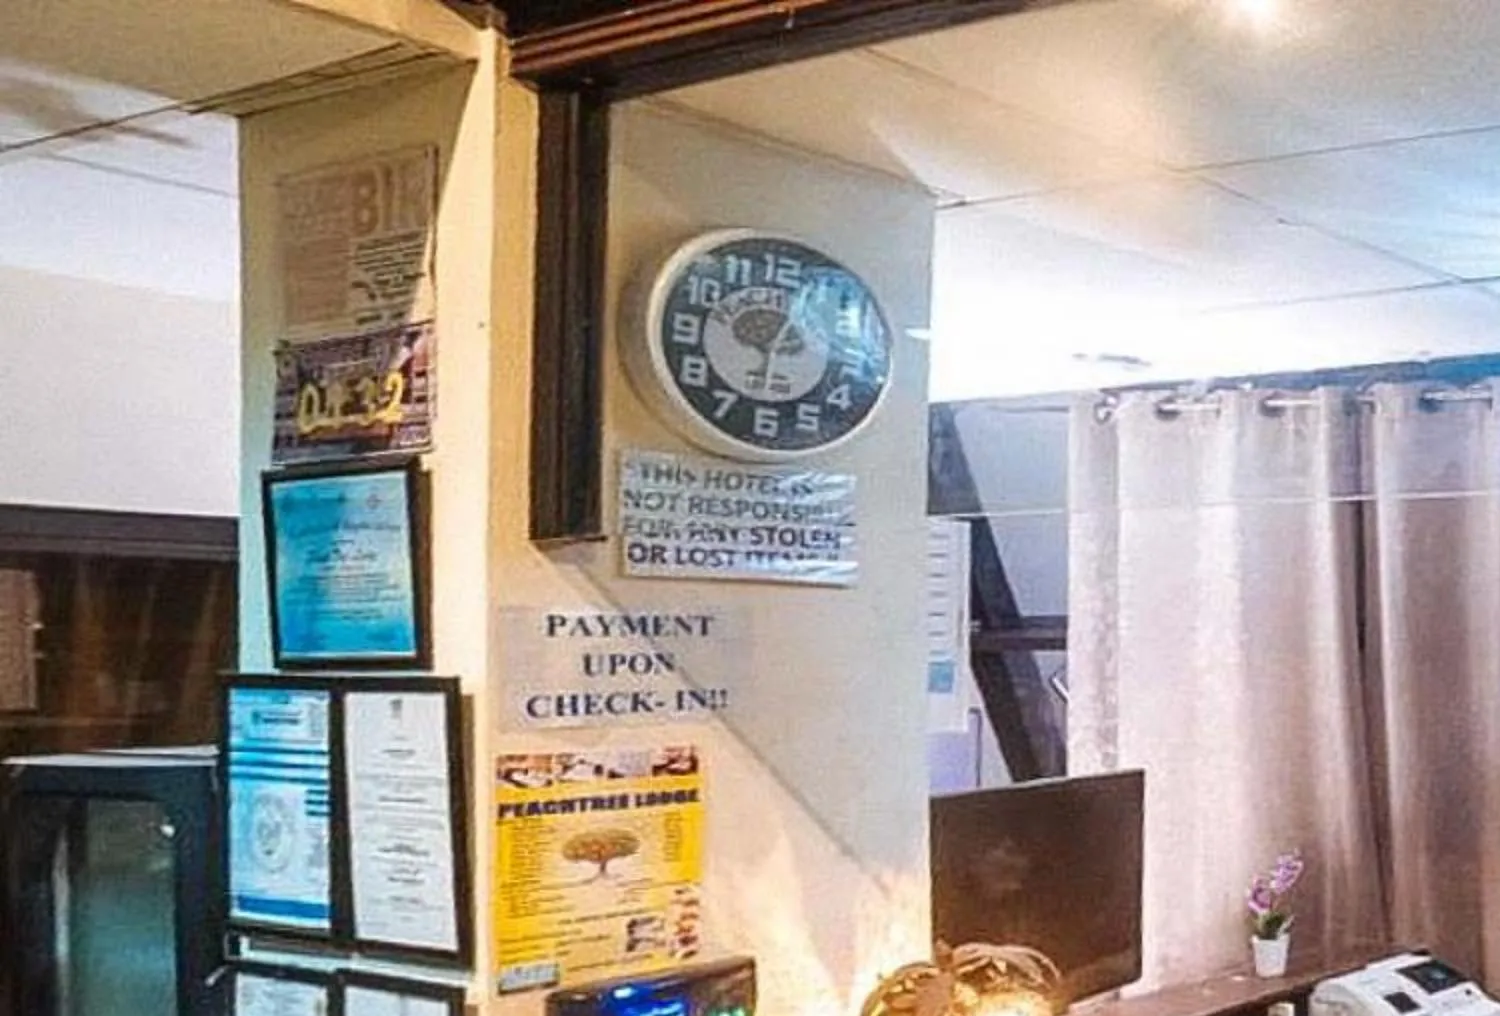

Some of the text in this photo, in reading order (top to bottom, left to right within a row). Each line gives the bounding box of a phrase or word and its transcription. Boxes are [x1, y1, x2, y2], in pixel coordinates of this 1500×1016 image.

[726, 254, 751, 285] 11
[764, 254, 801, 288] 12
[685, 276, 721, 307] 10
[672, 312, 699, 345] 9
[680, 355, 708, 387] 8
[712, 390, 739, 418] 7
[827, 384, 850, 410] 4
[754, 406, 780, 437] 6
[796, 402, 821, 431] 5
[639, 462, 697, 485] THIS
[623, 489, 842, 522] NOT RESPONSI
[623, 516, 841, 550] FOR ANY STOLEN
[627, 543, 667, 564] OR
[674, 547, 735, 567] LOST
[546, 614, 714, 637] PAYMENT
[583, 653, 675, 677] UPON
[498, 788, 699, 819] PEACHTREE LODGE
